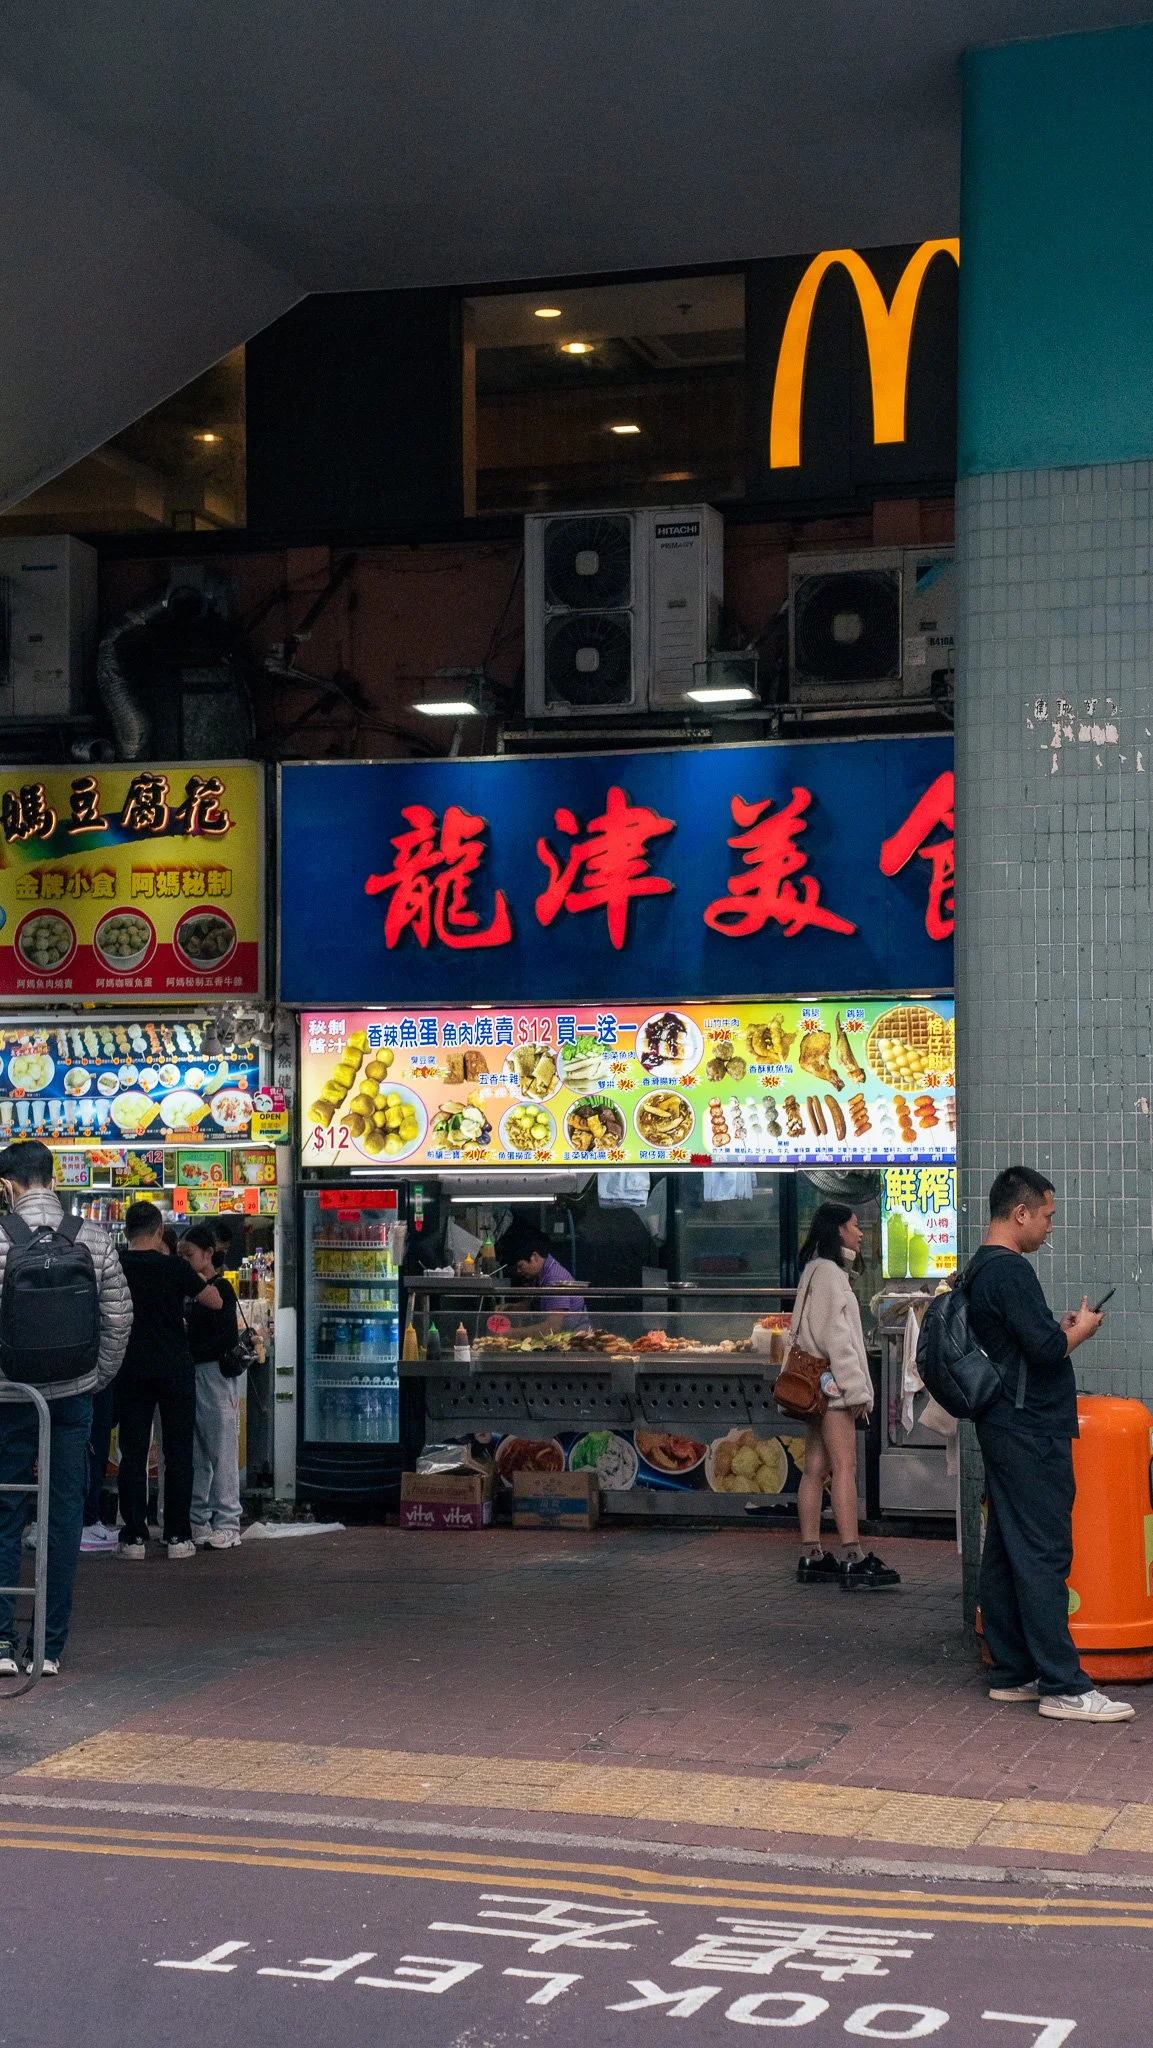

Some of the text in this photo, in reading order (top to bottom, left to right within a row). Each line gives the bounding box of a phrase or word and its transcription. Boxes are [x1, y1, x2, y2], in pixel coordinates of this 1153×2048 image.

[657, 525, 697, 535] HITACHI
[0, 772, 234, 843] 媽豆腐花
[15, 869, 232, 900] 金牌小食 阿媽秘制
[308, 1019, 346, 1035] 秘制
[367, 1015, 637, 1047] 香辣魚蛋 魚肉燒賣 $12 買一送一
[704, 1019, 740, 1028] 山竹牛肉
[308, 1038, 346, 1054] 醬汁
[927, 1018, 944, 1069] 格仔餅
[602, 1051, 636, 1060] 生菜魚肉
[313, 1126, 349, 1151] $12
[141, 1151, 163, 1163] $12
[74, 1171, 87, 1183] $6
[201, 1163, 223, 1182] $6
[256, 1165, 275, 1181] $8
[885, 1169, 957, 1213] 鮮榨
[203, 1198, 217, 1211] $7
[926, 1218, 948, 1228] 小樽
[927, 1233, 949, 1243] 大樽
[406, 1505, 435, 1523] vita
[442, 1507, 474, 1524] vita
[428, 1894, 935, 1982] 望左
[154, 1940, 1077, 2048] LOOK LEFT
